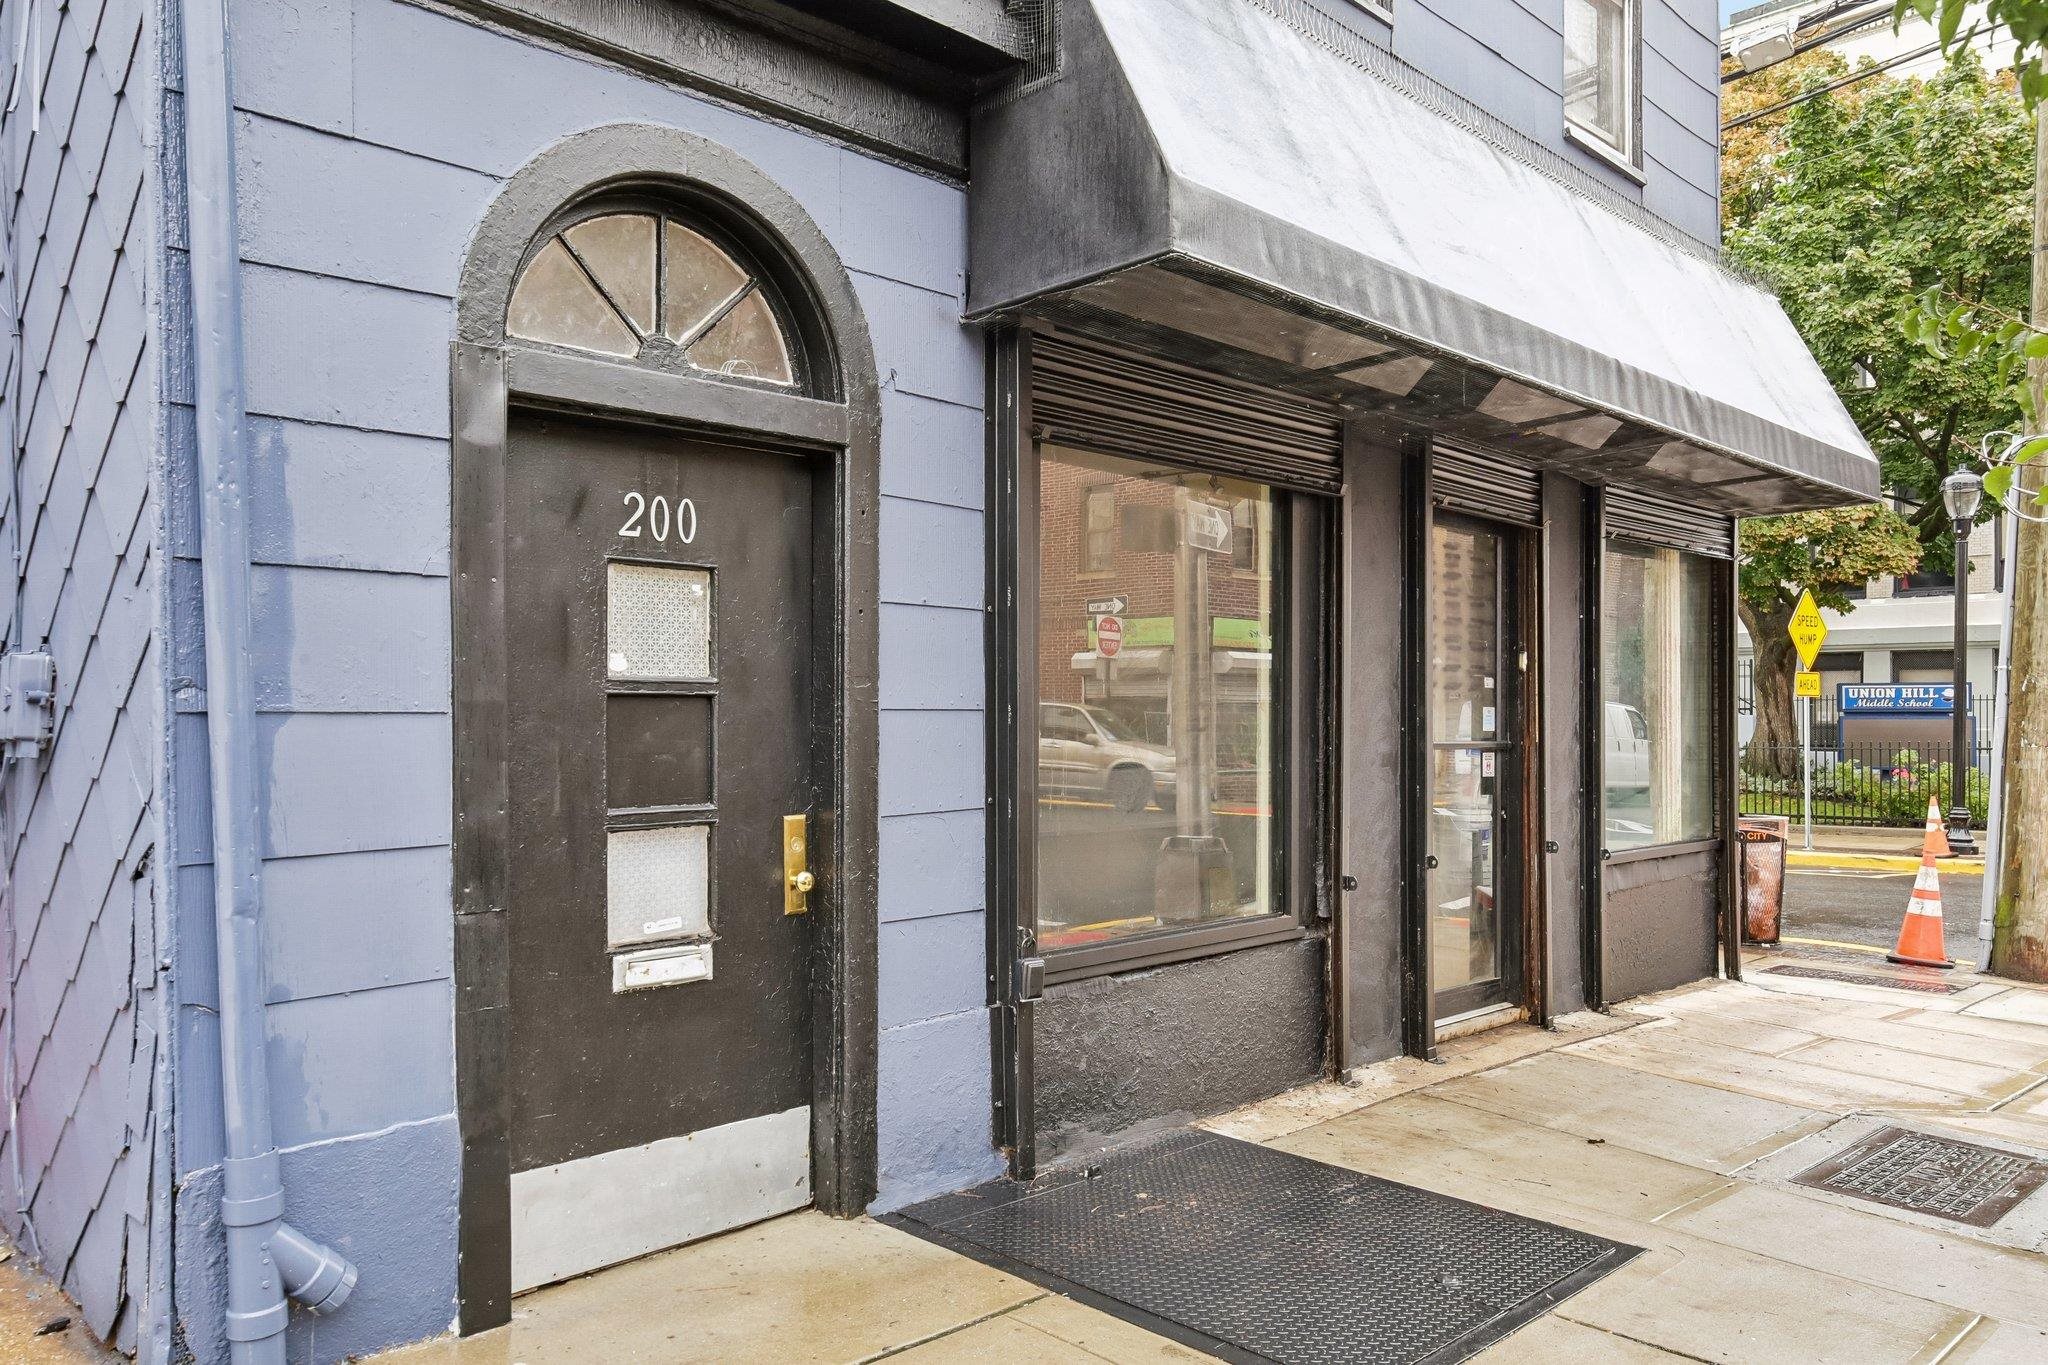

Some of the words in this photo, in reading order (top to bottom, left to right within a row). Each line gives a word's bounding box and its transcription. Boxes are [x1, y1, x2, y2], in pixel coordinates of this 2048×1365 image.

[618, 491, 697, 544] 200
[1797, 614, 1819, 628] SPEED
[1800, 633, 1817, 645] HUMP
[1799, 679, 1818, 691] AHEAD
[1848, 687, 1896, 698] UNION
[1901, 687, 1939, 698] HILL
[1853, 698, 1895, 707] Middle
[1896, 698, 1934, 707] School
[1747, 832, 1767, 840] CITY
